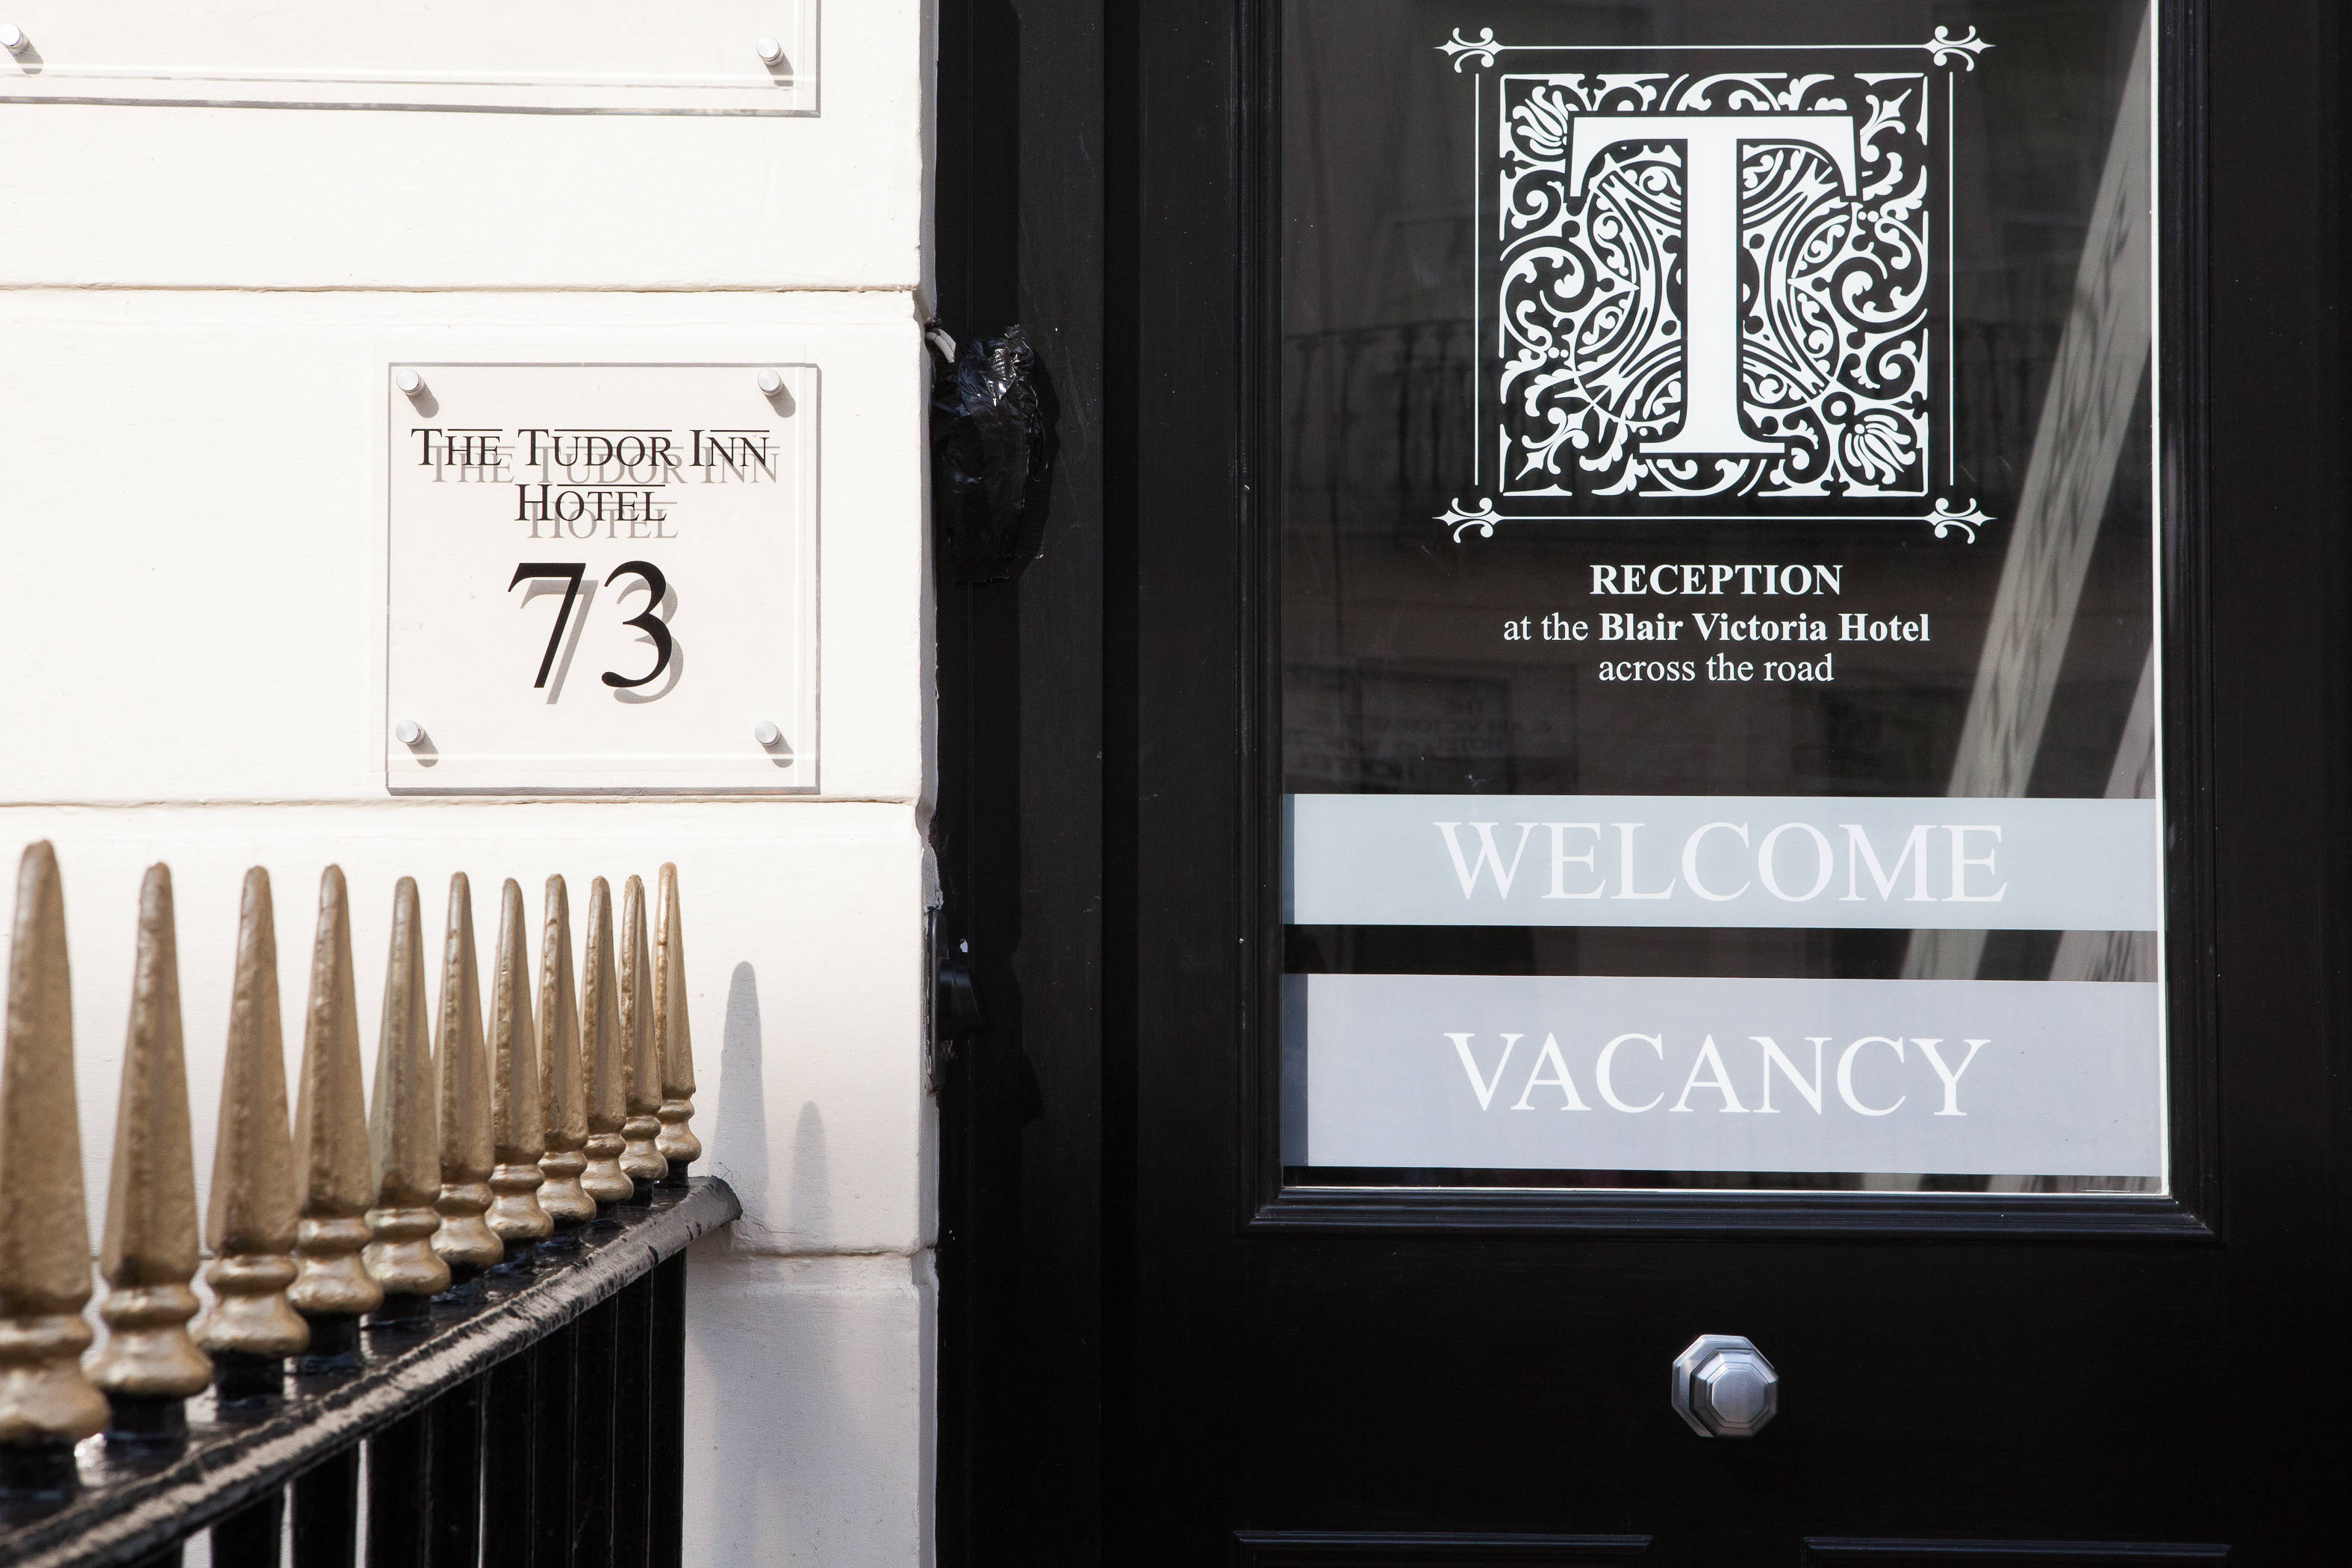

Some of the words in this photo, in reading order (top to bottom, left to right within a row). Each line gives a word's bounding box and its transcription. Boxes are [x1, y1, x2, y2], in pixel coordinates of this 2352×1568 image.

[1569, 116, 1857, 453] T
[411, 429, 503, 466] THE
[517, 429, 677, 467] TUDOR
[689, 429, 770, 467] INN
[514, 484, 667, 522] HOTEL
[1590, 564, 1844, 596] RECEPTION
[508, 560, 673, 688] 73
[1503, 615, 1532, 642] at
[1540, 612, 1589, 642] the
[1599, 612, 1684, 641] Blair
[1691, 612, 1829, 643] Victoria
[1838, 612, 1930, 642] Hotel
[1598, 658, 1696, 682] across
[1705, 654, 1755, 682] the
[1763, 653, 1835, 682] road
[1433, 821, 2008, 902] WELCOME
[1443, 1032, 1991, 1116] VACANCY
